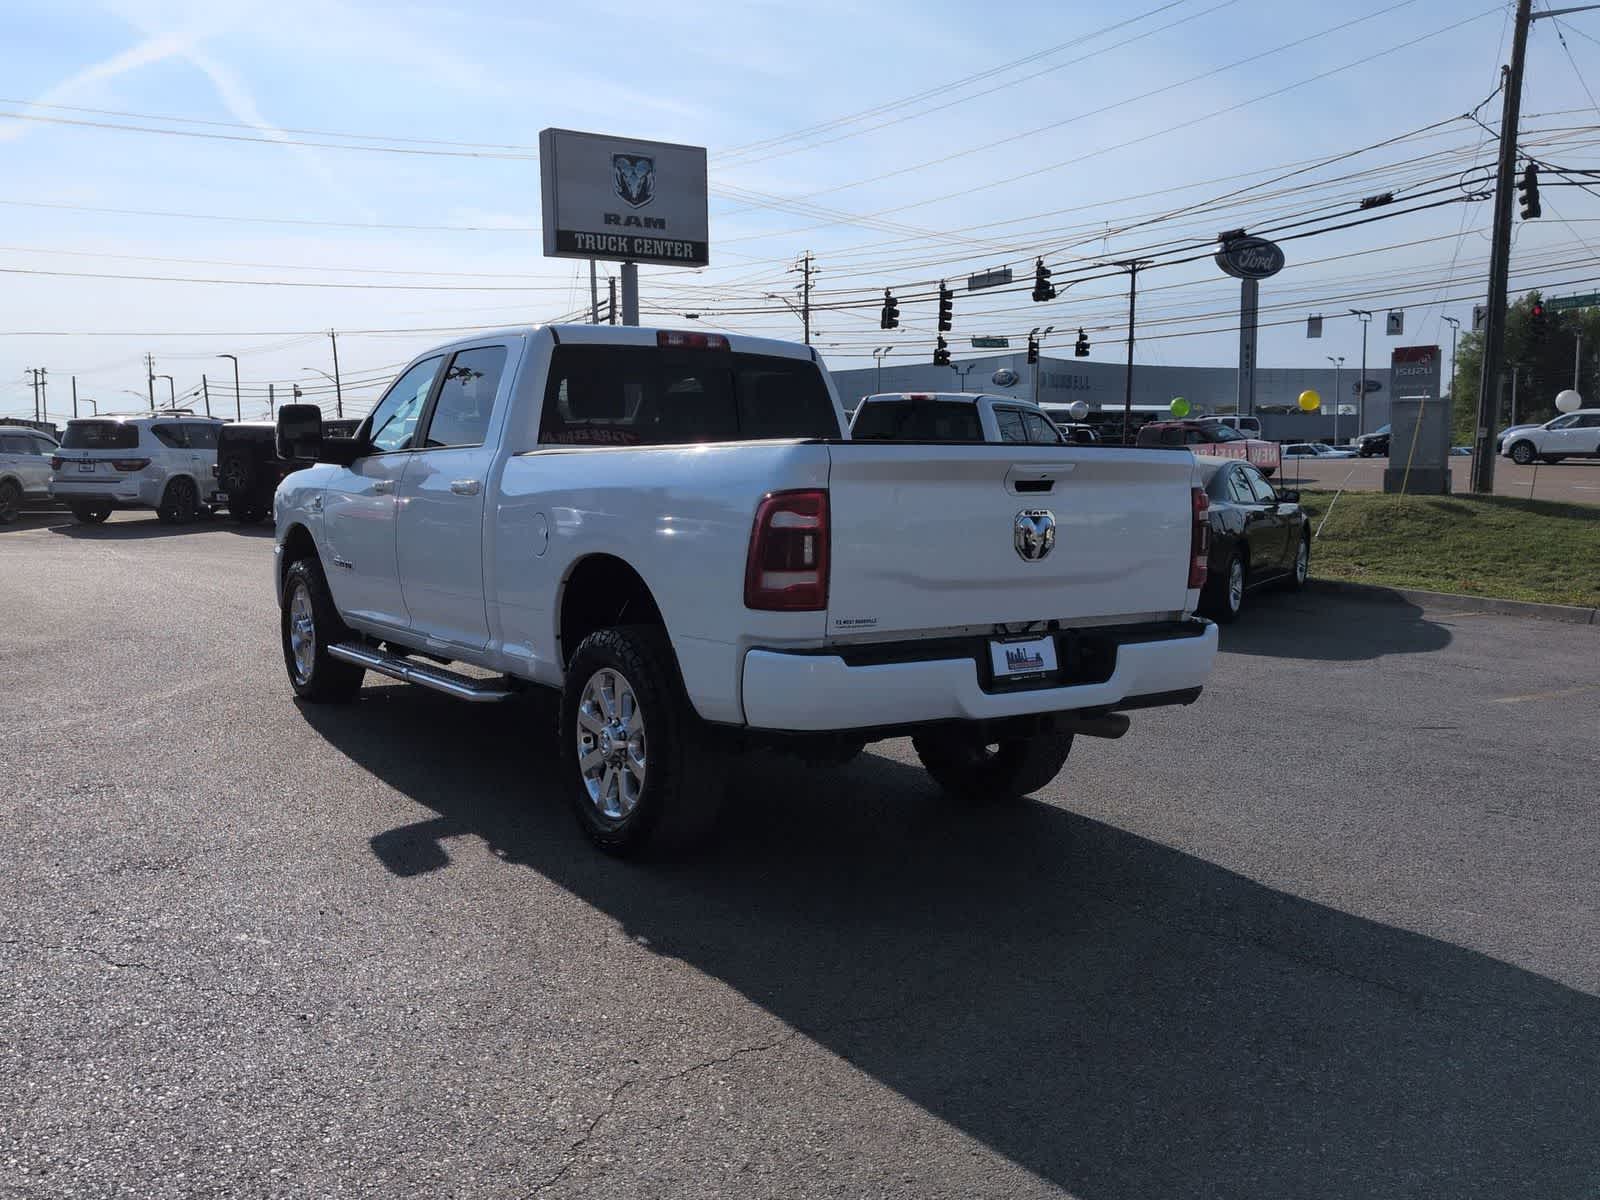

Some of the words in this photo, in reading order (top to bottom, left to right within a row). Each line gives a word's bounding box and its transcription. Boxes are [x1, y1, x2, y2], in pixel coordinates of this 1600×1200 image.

[603, 213, 666, 230] RAM
[574, 233, 629, 253] TRUCK
[633, 239, 694, 258] CENTER
[1238, 246, 1274, 271] Ford
